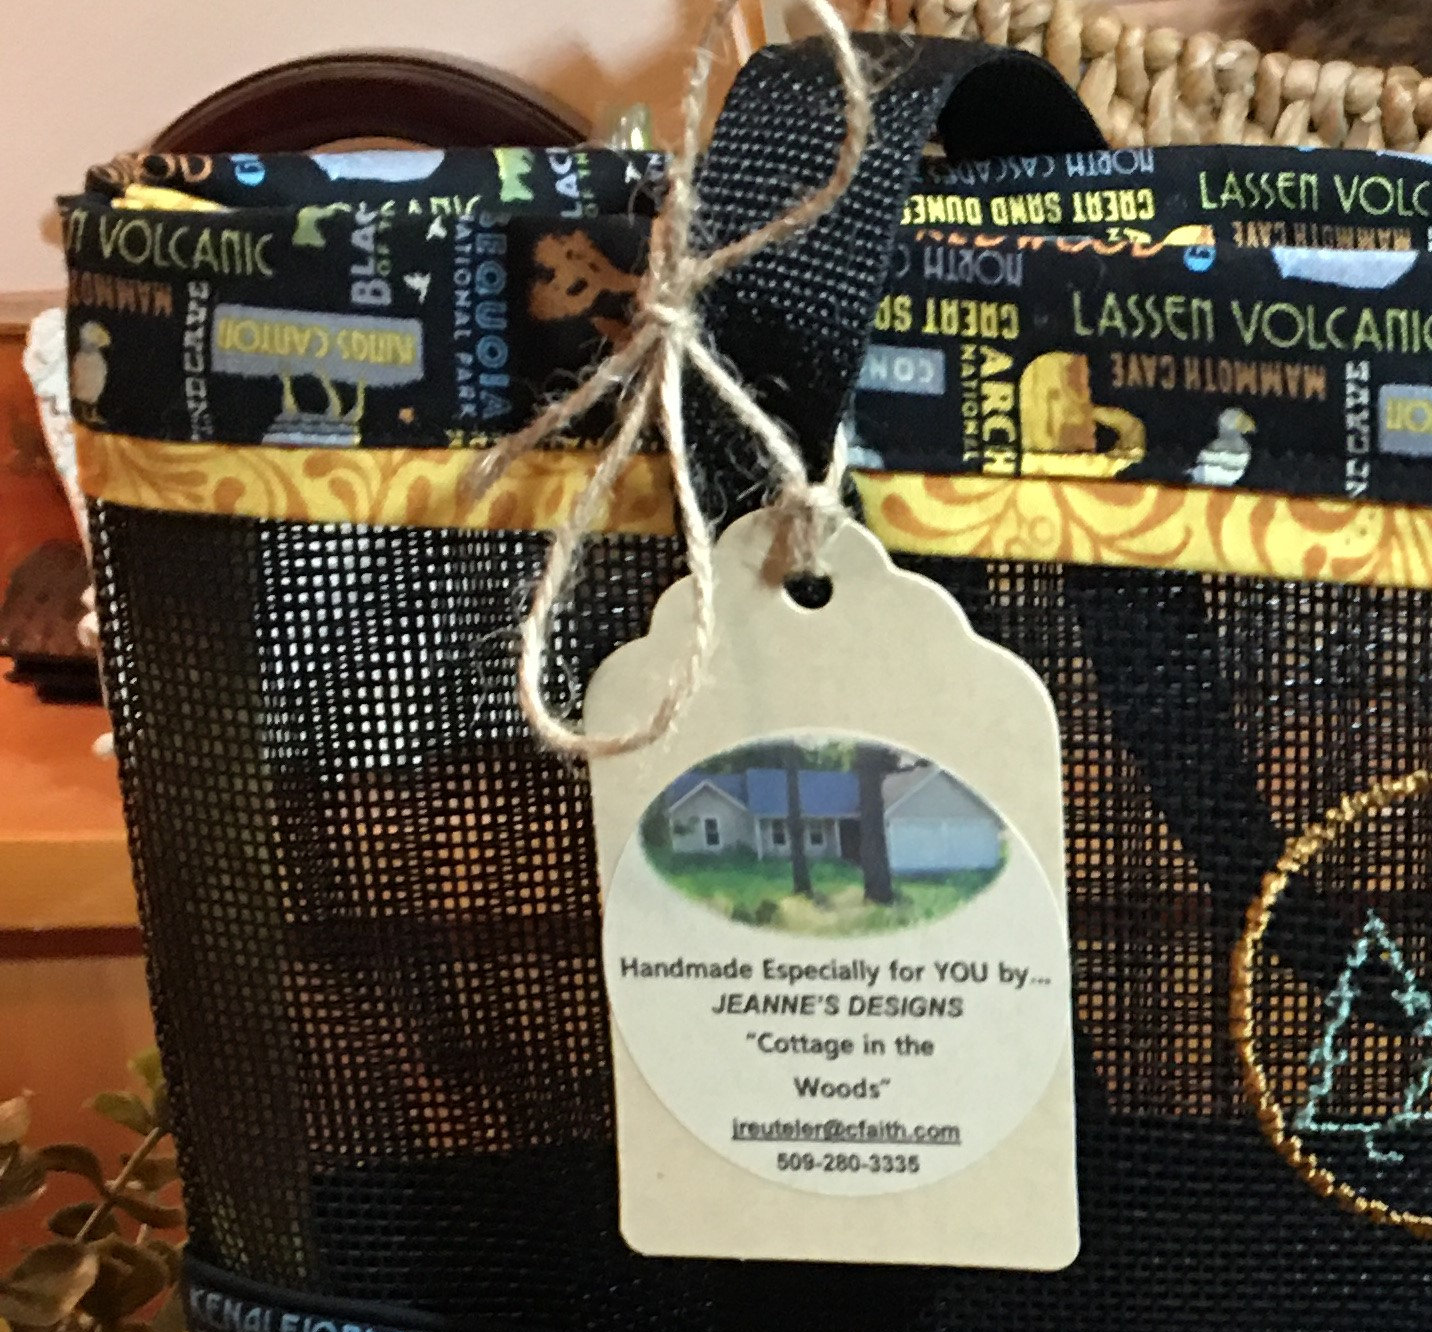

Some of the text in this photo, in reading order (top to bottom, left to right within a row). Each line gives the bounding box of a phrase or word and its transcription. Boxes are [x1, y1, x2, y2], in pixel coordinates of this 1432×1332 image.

[1199, 170, 1319, 213] LASSEN
[993, 192, 1062, 227] SAND
[98, 218, 276, 279] VOLCANIC
[923, 297, 1019, 339] GREAT
[1072, 290, 1214, 342] LASSEN
[1111, 351, 1327, 399] MAMMOTH CAVE
[620, 957, 1051, 988] Handmade Especially for YOU by...
[711, 994, 964, 1018] JEANNE'S DESIGNS
[747, 1031, 934, 1060] "Cottage in the
[794, 1076, 891, 1099] Woods"
[732, 1118, 961, 1144] jreuteler@cfaith.com
[777, 1153, 920, 1173] 509-280-3335
